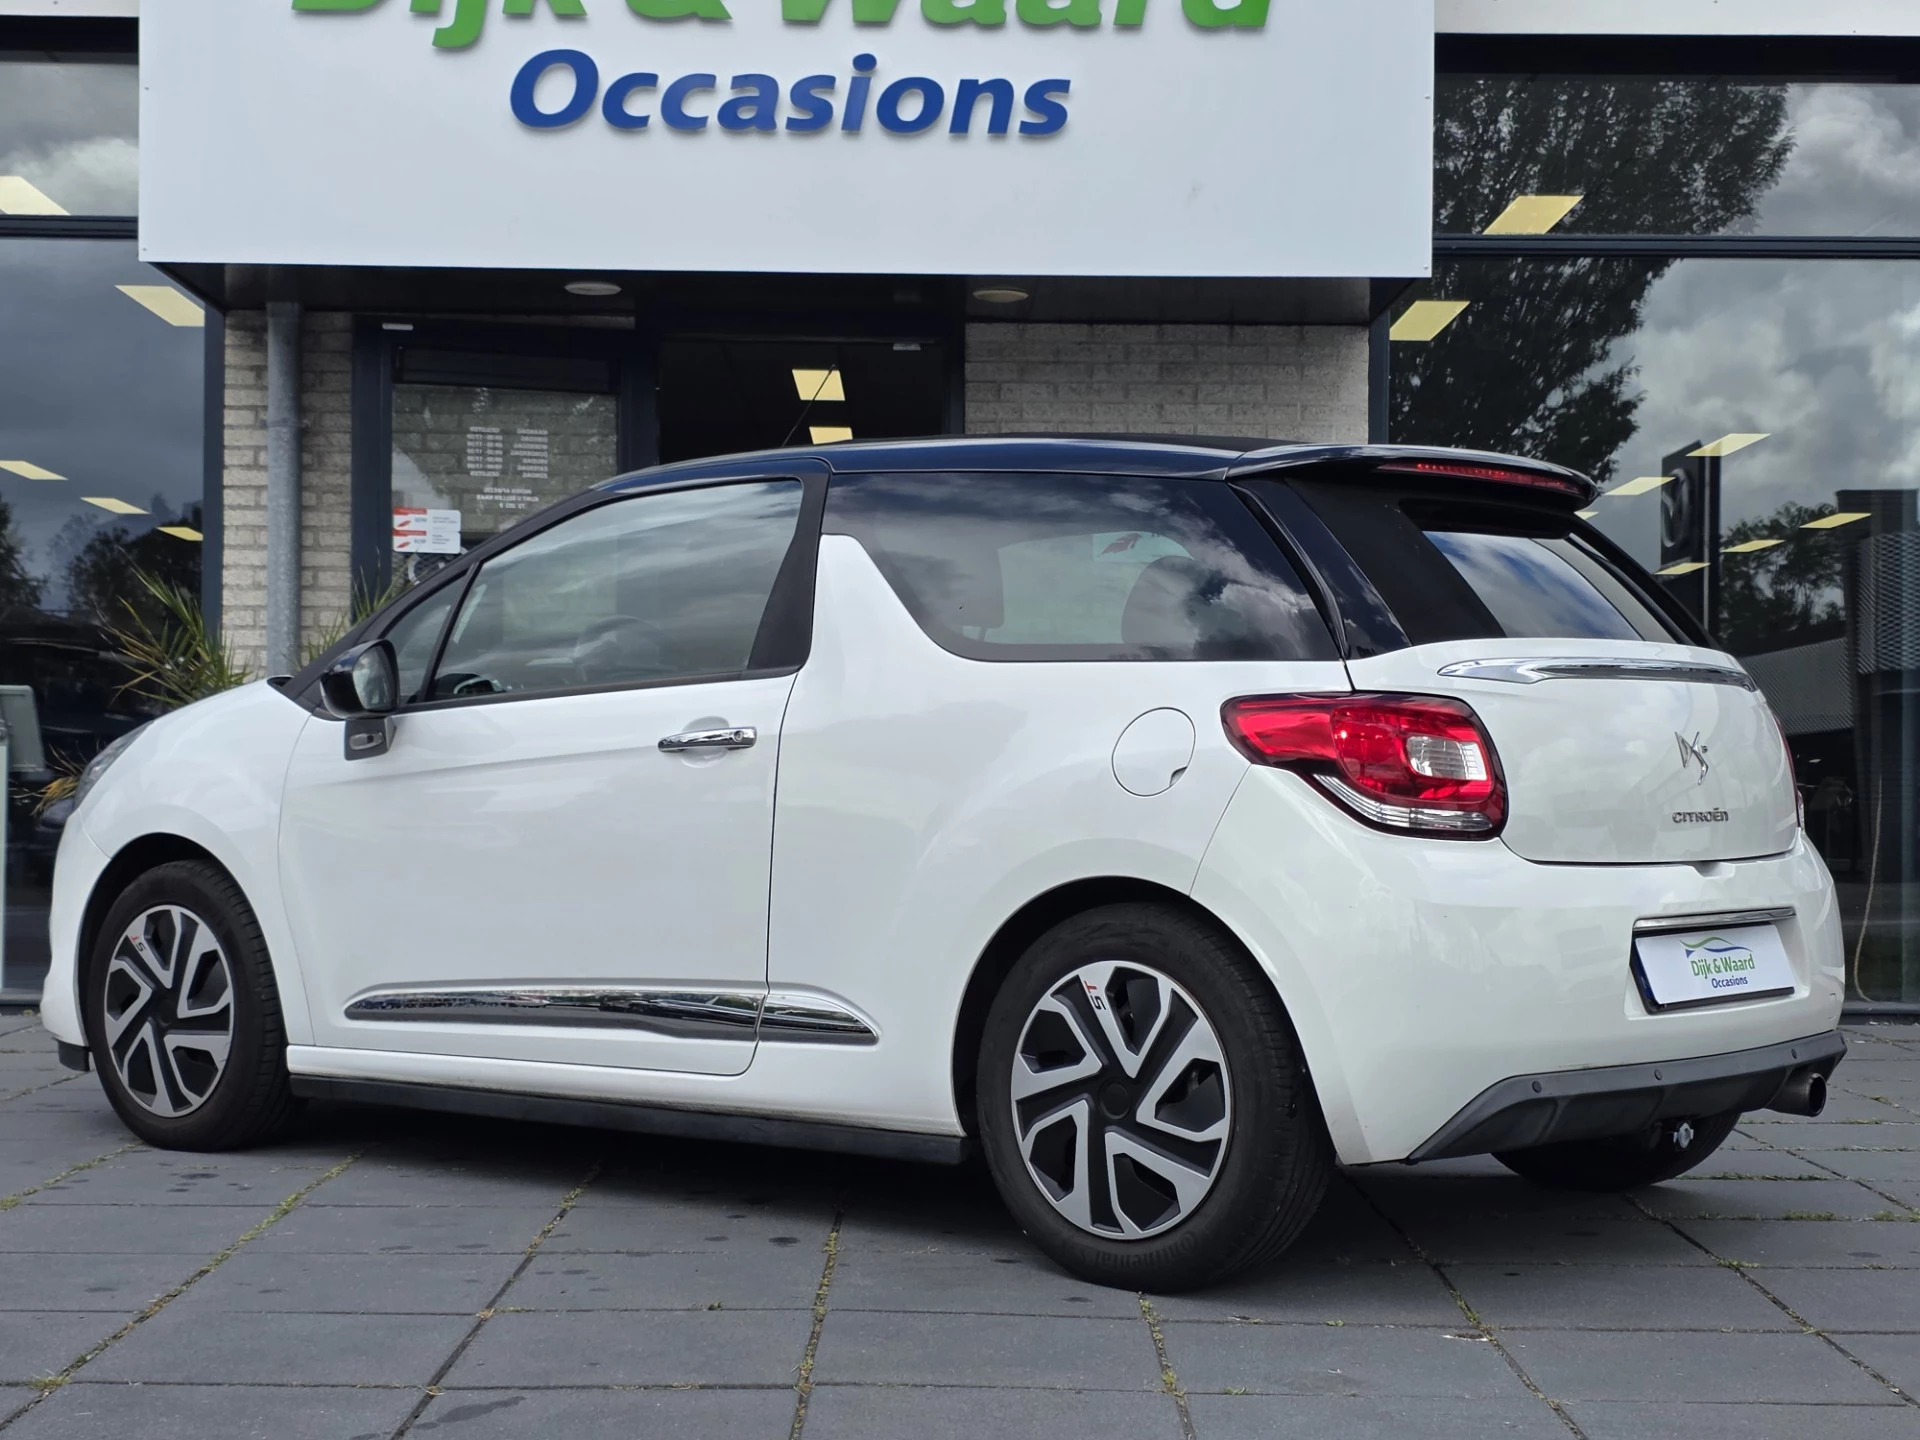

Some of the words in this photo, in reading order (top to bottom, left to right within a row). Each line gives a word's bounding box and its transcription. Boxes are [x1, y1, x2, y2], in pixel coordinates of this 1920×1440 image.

[510, 48, 1071, 136] Occasions
[1690, 958, 1713, 979] Dijk
[1713, 958, 1722, 974] &
[1720, 953, 1755, 973] Waard
[1084, 980, 1107, 1010] ST
[1711, 975, 1748, 989] Occasions
